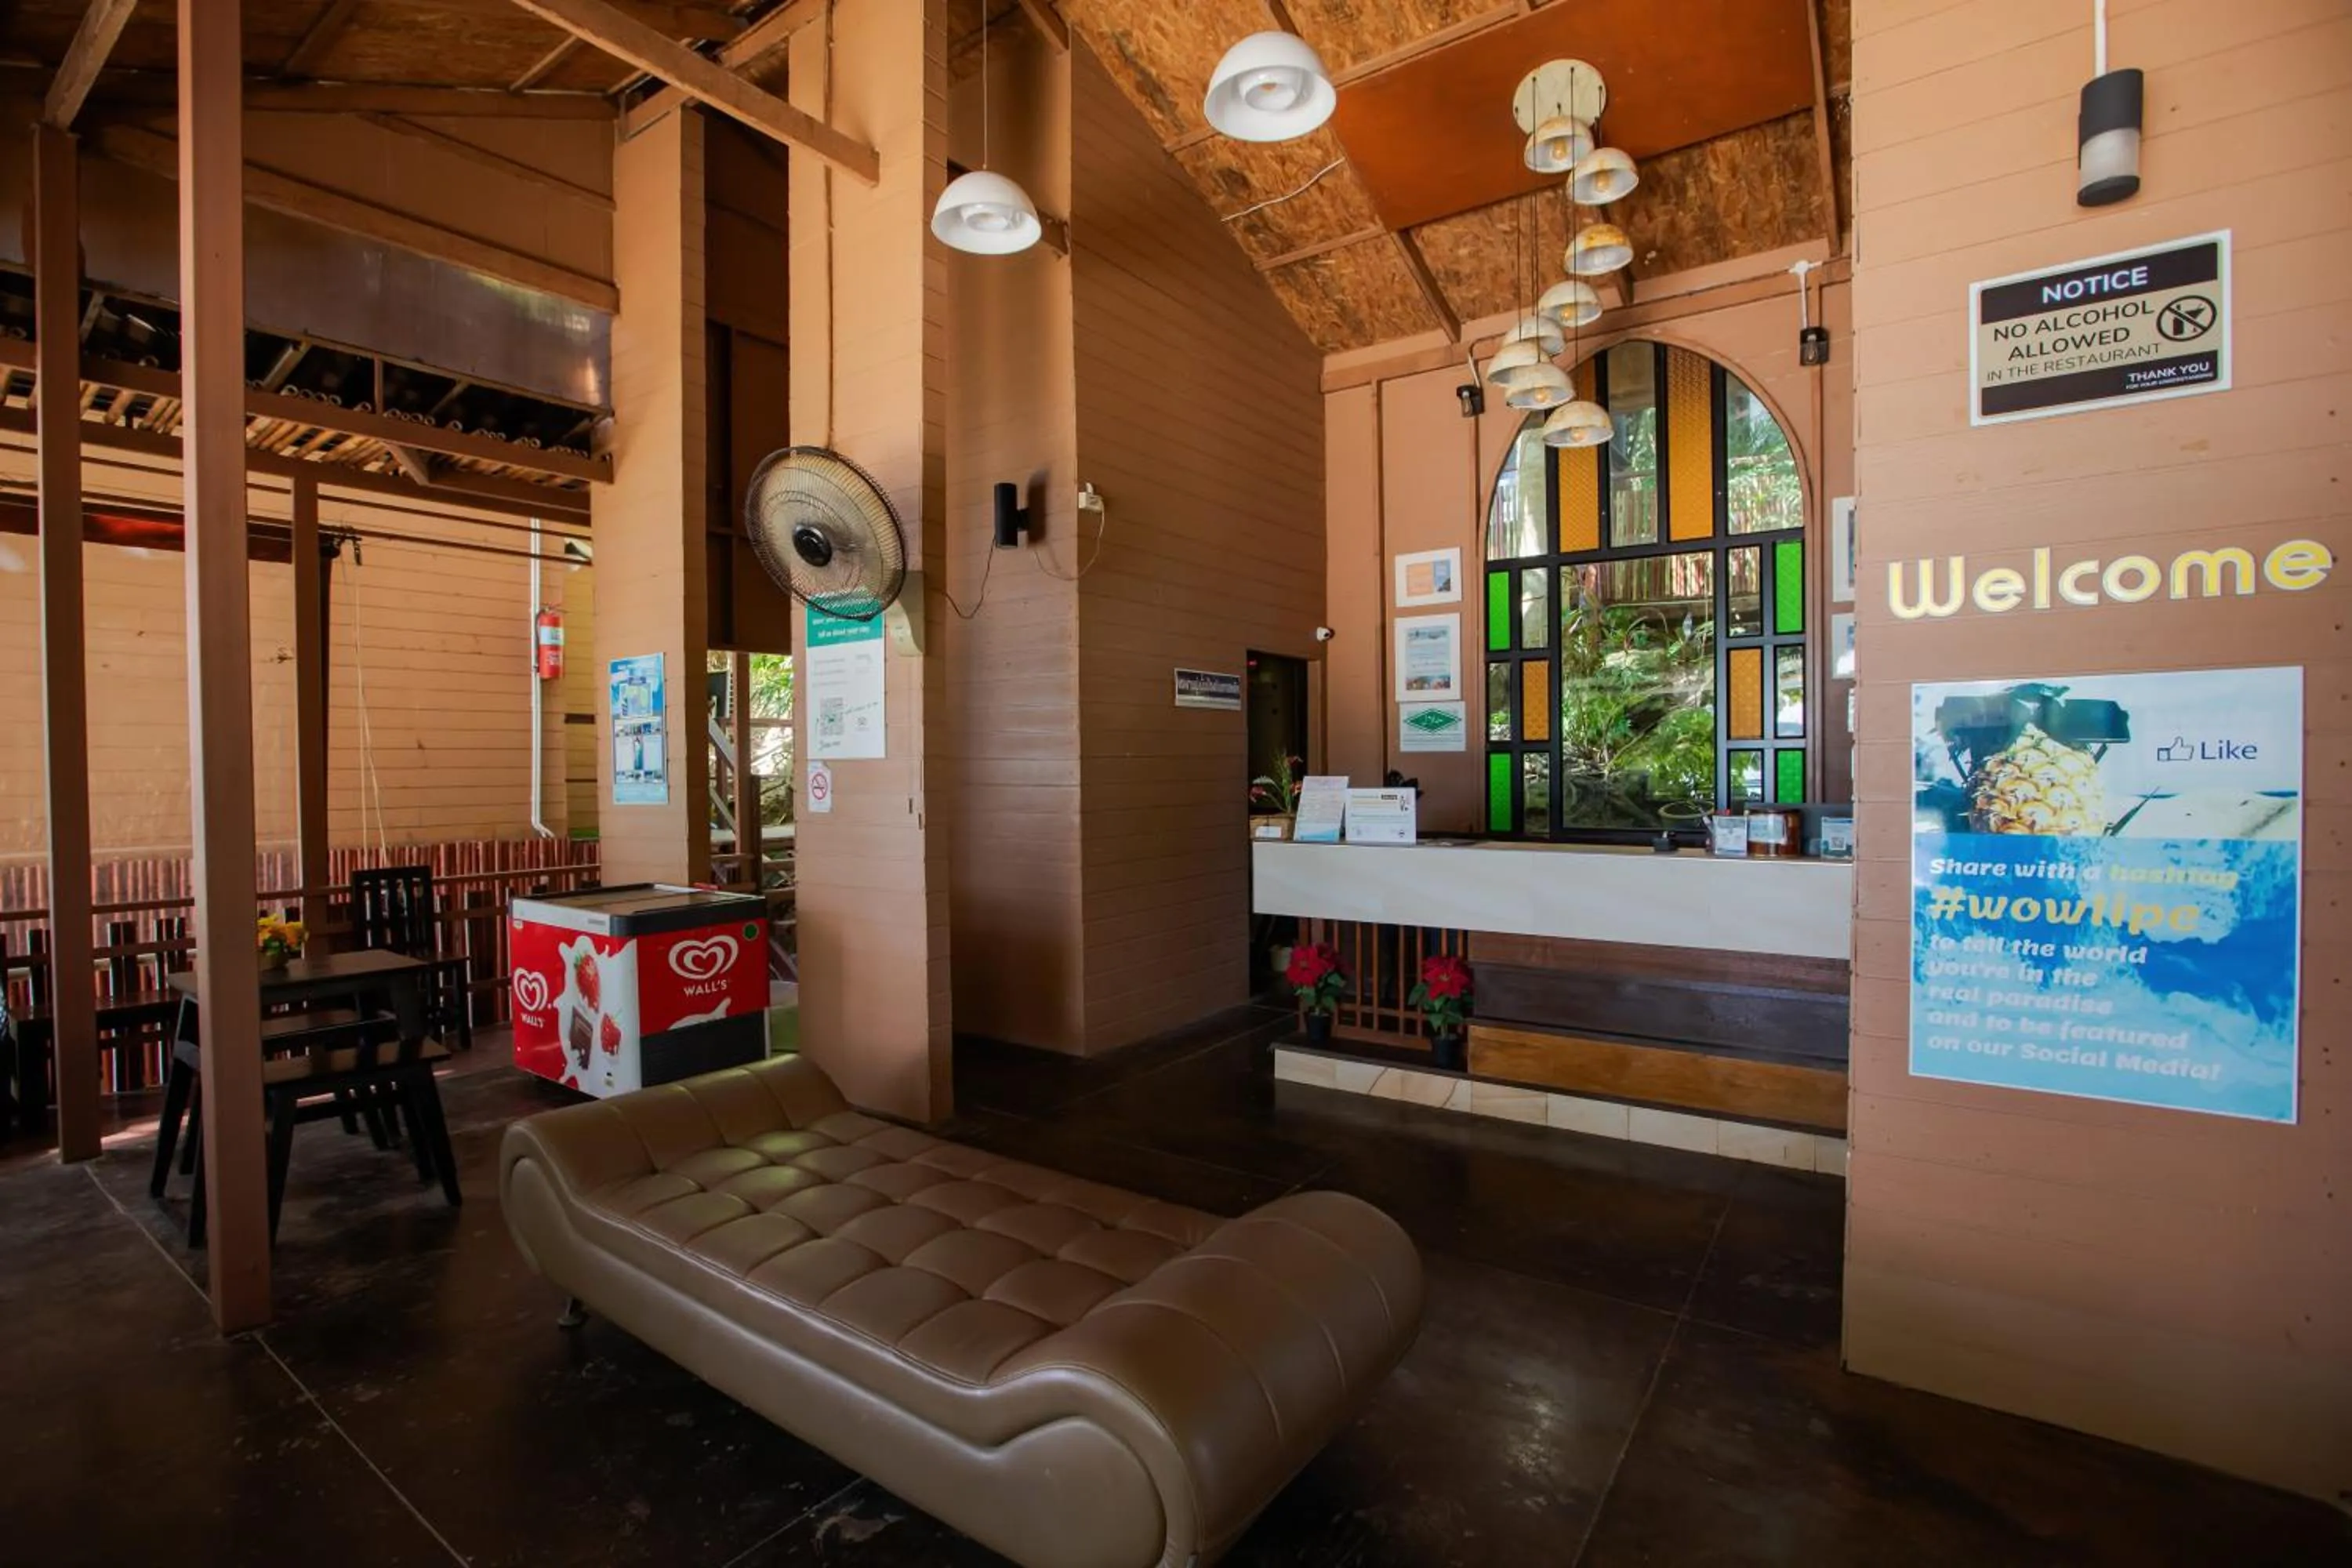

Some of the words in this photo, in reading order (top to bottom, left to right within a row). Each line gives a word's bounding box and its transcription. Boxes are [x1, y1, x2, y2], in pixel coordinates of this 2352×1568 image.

[2042, 266, 2148, 303] NOTICE
[1994, 323, 2027, 342] NO
[2035, 300, 2154, 335] ALCOHOL
[2008, 327, 2130, 361] ALLOWED
[1987, 369, 2002, 381] IN
[2007, 362, 2039, 378] THE
[2044, 343, 2161, 372] RESTAURANT
[2127, 367, 2176, 383] THANK
[2180, 361, 2210, 374] YOU
[1888, 539, 2333, 619] Welcome
[2201, 739, 2257, 760] Like
[1929, 858, 2006, 877] Share
[2014, 860, 2076, 880] with
[2082, 866, 2102, 881] a
[2109, 863, 2239, 890] hashtag
[1929, 934, 1956, 951] to
[1962, 935, 2005, 954] tell
[2011, 938, 2055, 957] the
[2063, 944, 2147, 964] world
[683, 979, 728, 997] WALL'S
[1927, 960, 2009, 979] you're
[2017, 963, 2044, 984] in
[2053, 967, 2098, 987] the
[1929, 985, 1979, 1003] real
[1987, 990, 2113, 1014] paradise
[1927, 1011, 1978, 1028] and
[1987, 1014, 2012, 1031] to
[2020, 1017, 2053, 1035] be
[2060, 1020, 2189, 1049] featured
[1928, 1036, 1961, 1051] on
[1966, 1039, 2013, 1056] our
[2020, 1042, 2108, 1067] Social
[2115, 1053, 2222, 1081] Media!
